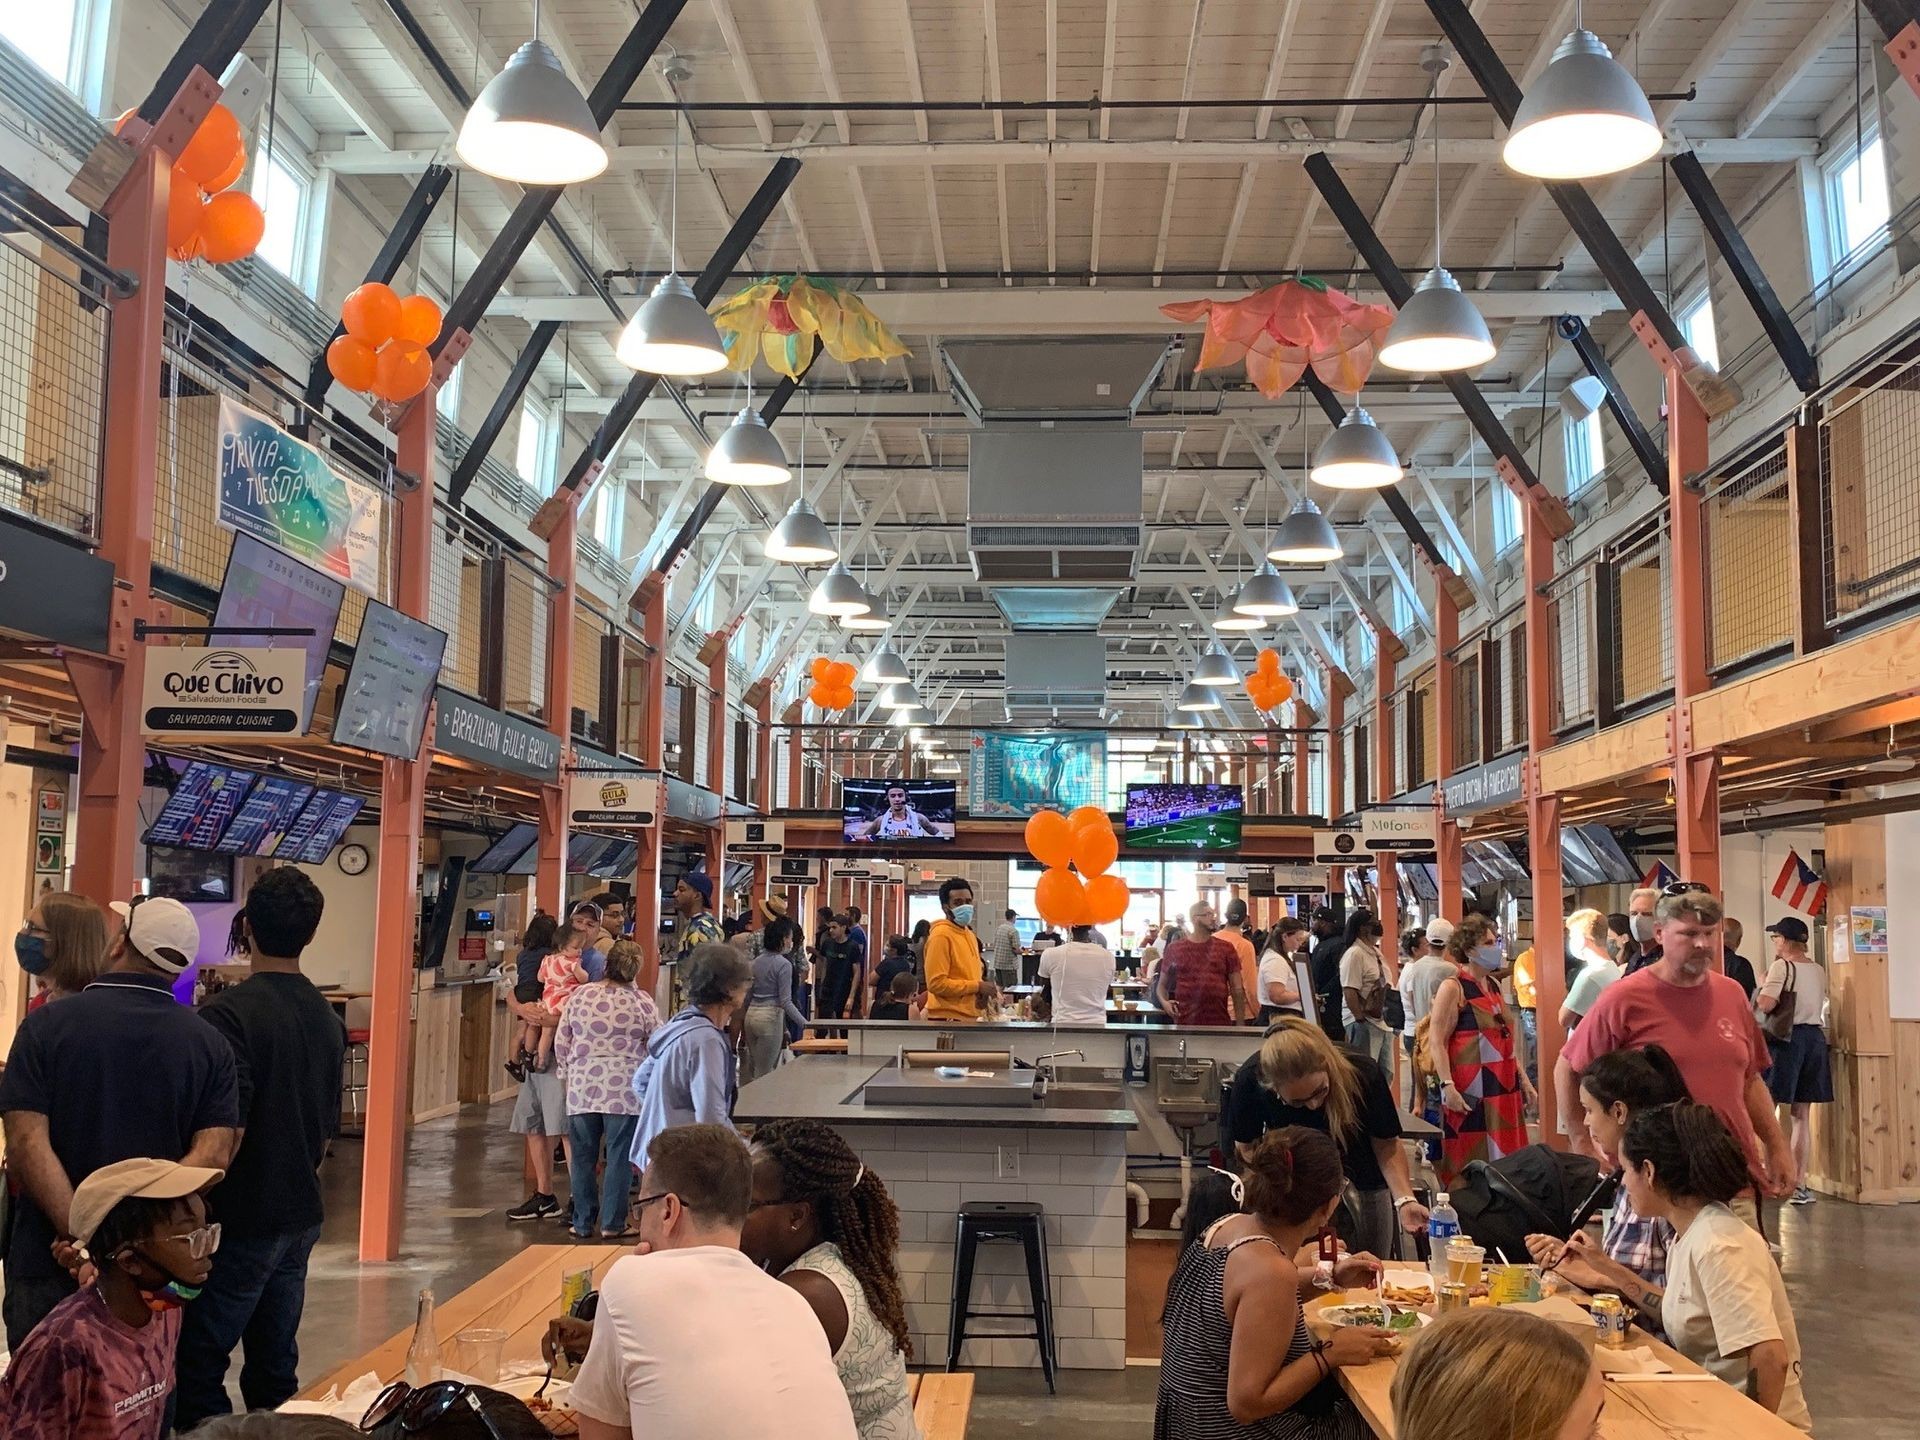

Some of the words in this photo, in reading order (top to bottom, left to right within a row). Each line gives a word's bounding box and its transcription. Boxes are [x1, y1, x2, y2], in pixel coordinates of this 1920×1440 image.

[222, 431, 279, 475] TRIVIA
[164, 672, 210, 697] Que
[215, 672, 284, 695] Chivo
[187, 694, 235, 704] Salvadorian
[237, 695, 259, 704] Food
[168, 713, 233, 725] SALVADORIAN
[236, 715, 275, 726] CUISINE
[451, 706, 502, 752] BRAZILIAN
[502, 727, 526, 760] GULA
[527, 736, 549, 769] GRILL
[602, 790, 626, 800] GULA
[972, 754, 985, 812] Heineken
[1446, 782, 1465, 809] PUERTO
[1466, 777, 1482, 804] RICAN
[1488, 763, 1520, 797] AMERICAN
